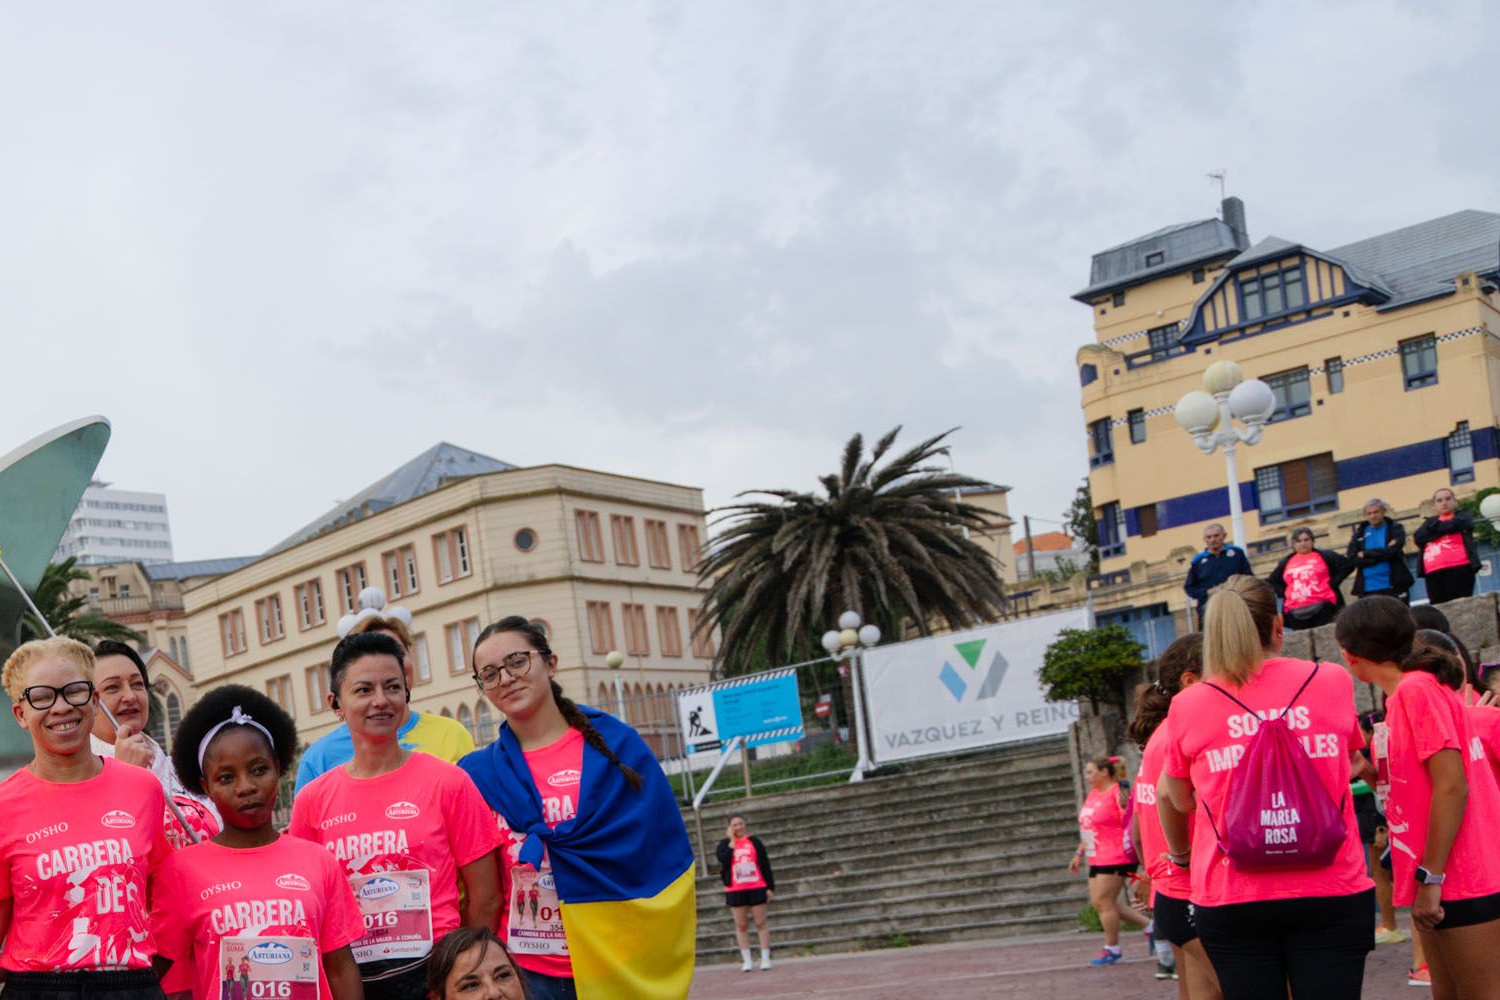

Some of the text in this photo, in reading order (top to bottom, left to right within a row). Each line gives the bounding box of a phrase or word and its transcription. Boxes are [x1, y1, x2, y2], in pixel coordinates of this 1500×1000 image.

[885, 719, 983, 749] VAZQUEZ
[991, 715, 1004, 731] Y
[1272, 791, 1286, 808] LA
[321, 812, 356, 831] OYSHO
[1260, 808, 1301, 826] MAREA
[26, 822, 68, 844] OYSHO
[1265, 827, 1297, 844] ROSA
[37, 838, 134, 880] CARRERA
[201, 881, 241, 900] OYSHO
[362, 885, 396, 896] ASTURIANA
[212, 899, 306, 935] CARRERA
[363, 911, 398, 929] 016
[541, 907, 562, 921] 01
[355, 950, 373, 958] SHO
[519, 941, 550, 950] OYSHO
[252, 950, 291, 960] ASTURIANA
[251, 981, 291, 998] 016
